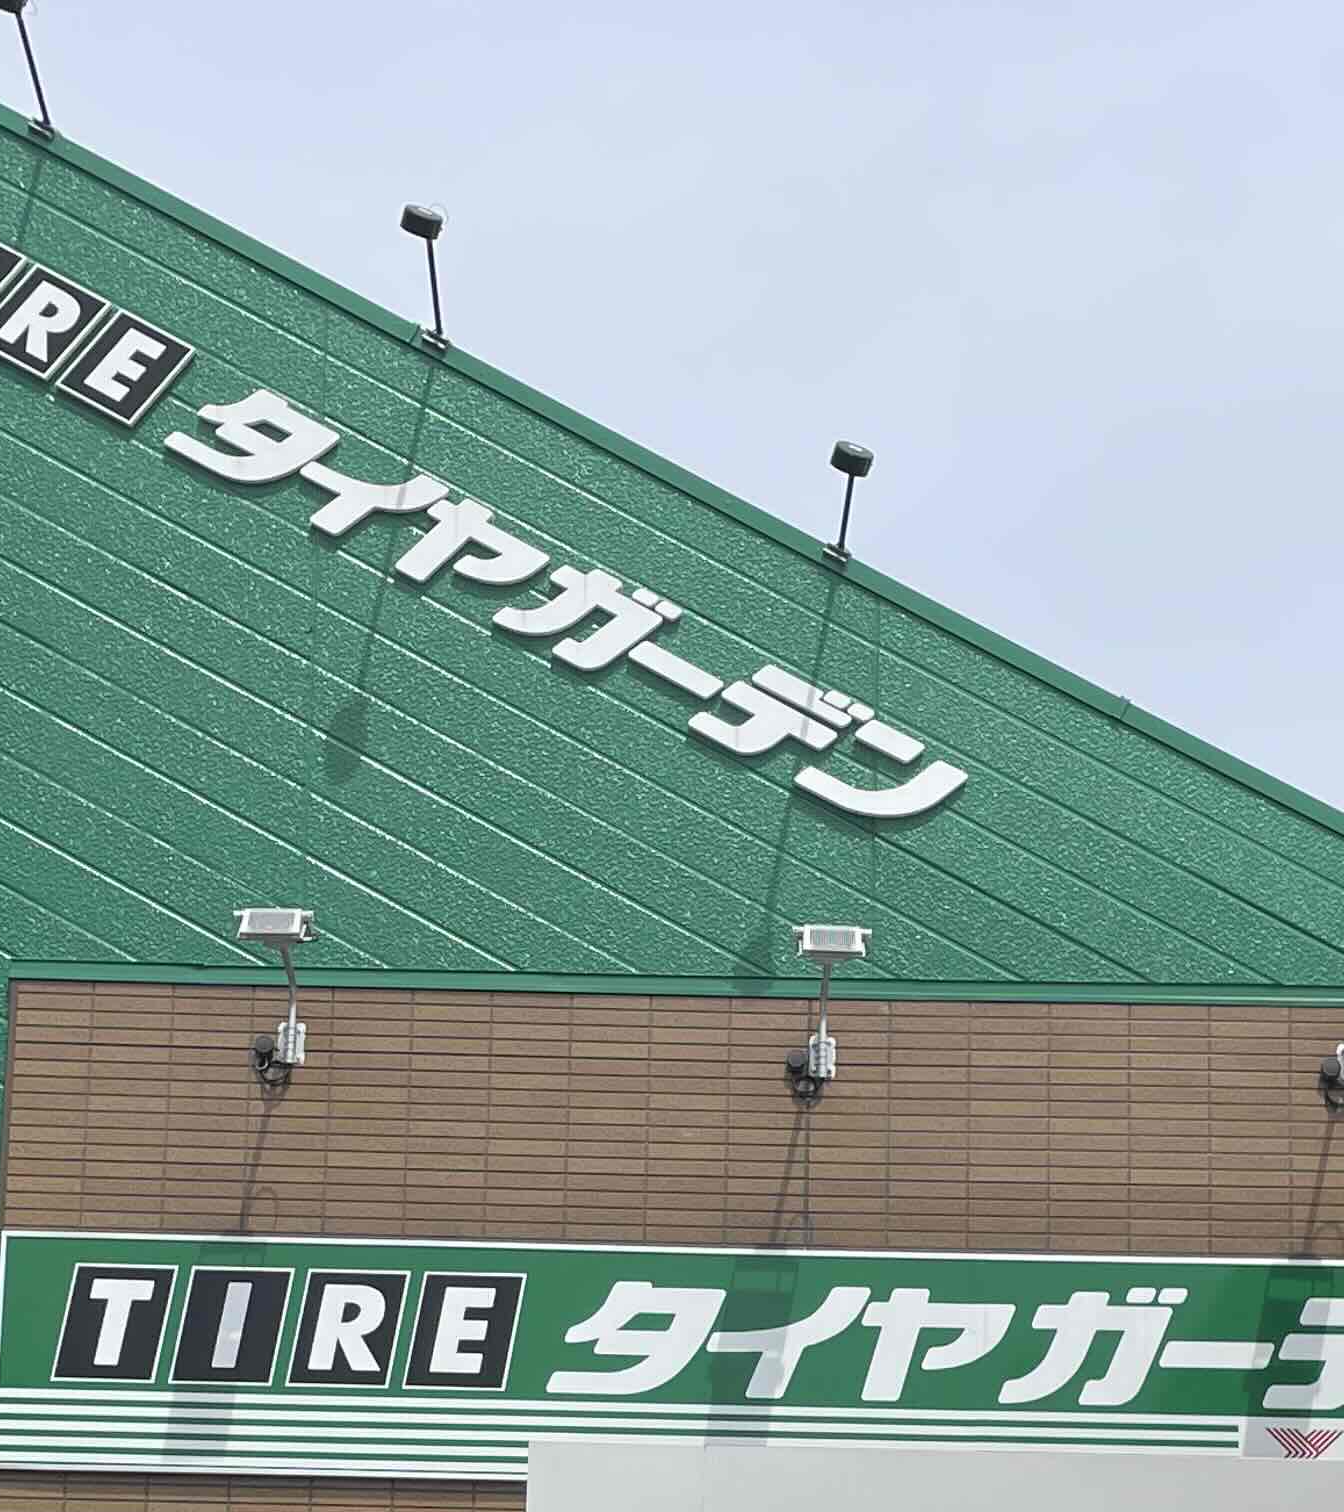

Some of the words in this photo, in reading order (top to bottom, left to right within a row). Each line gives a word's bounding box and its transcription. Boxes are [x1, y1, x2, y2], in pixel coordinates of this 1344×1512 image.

[163, 389, 969, 818] タイヤガーデン
[87, 1278, 497, 1375] TIRE
